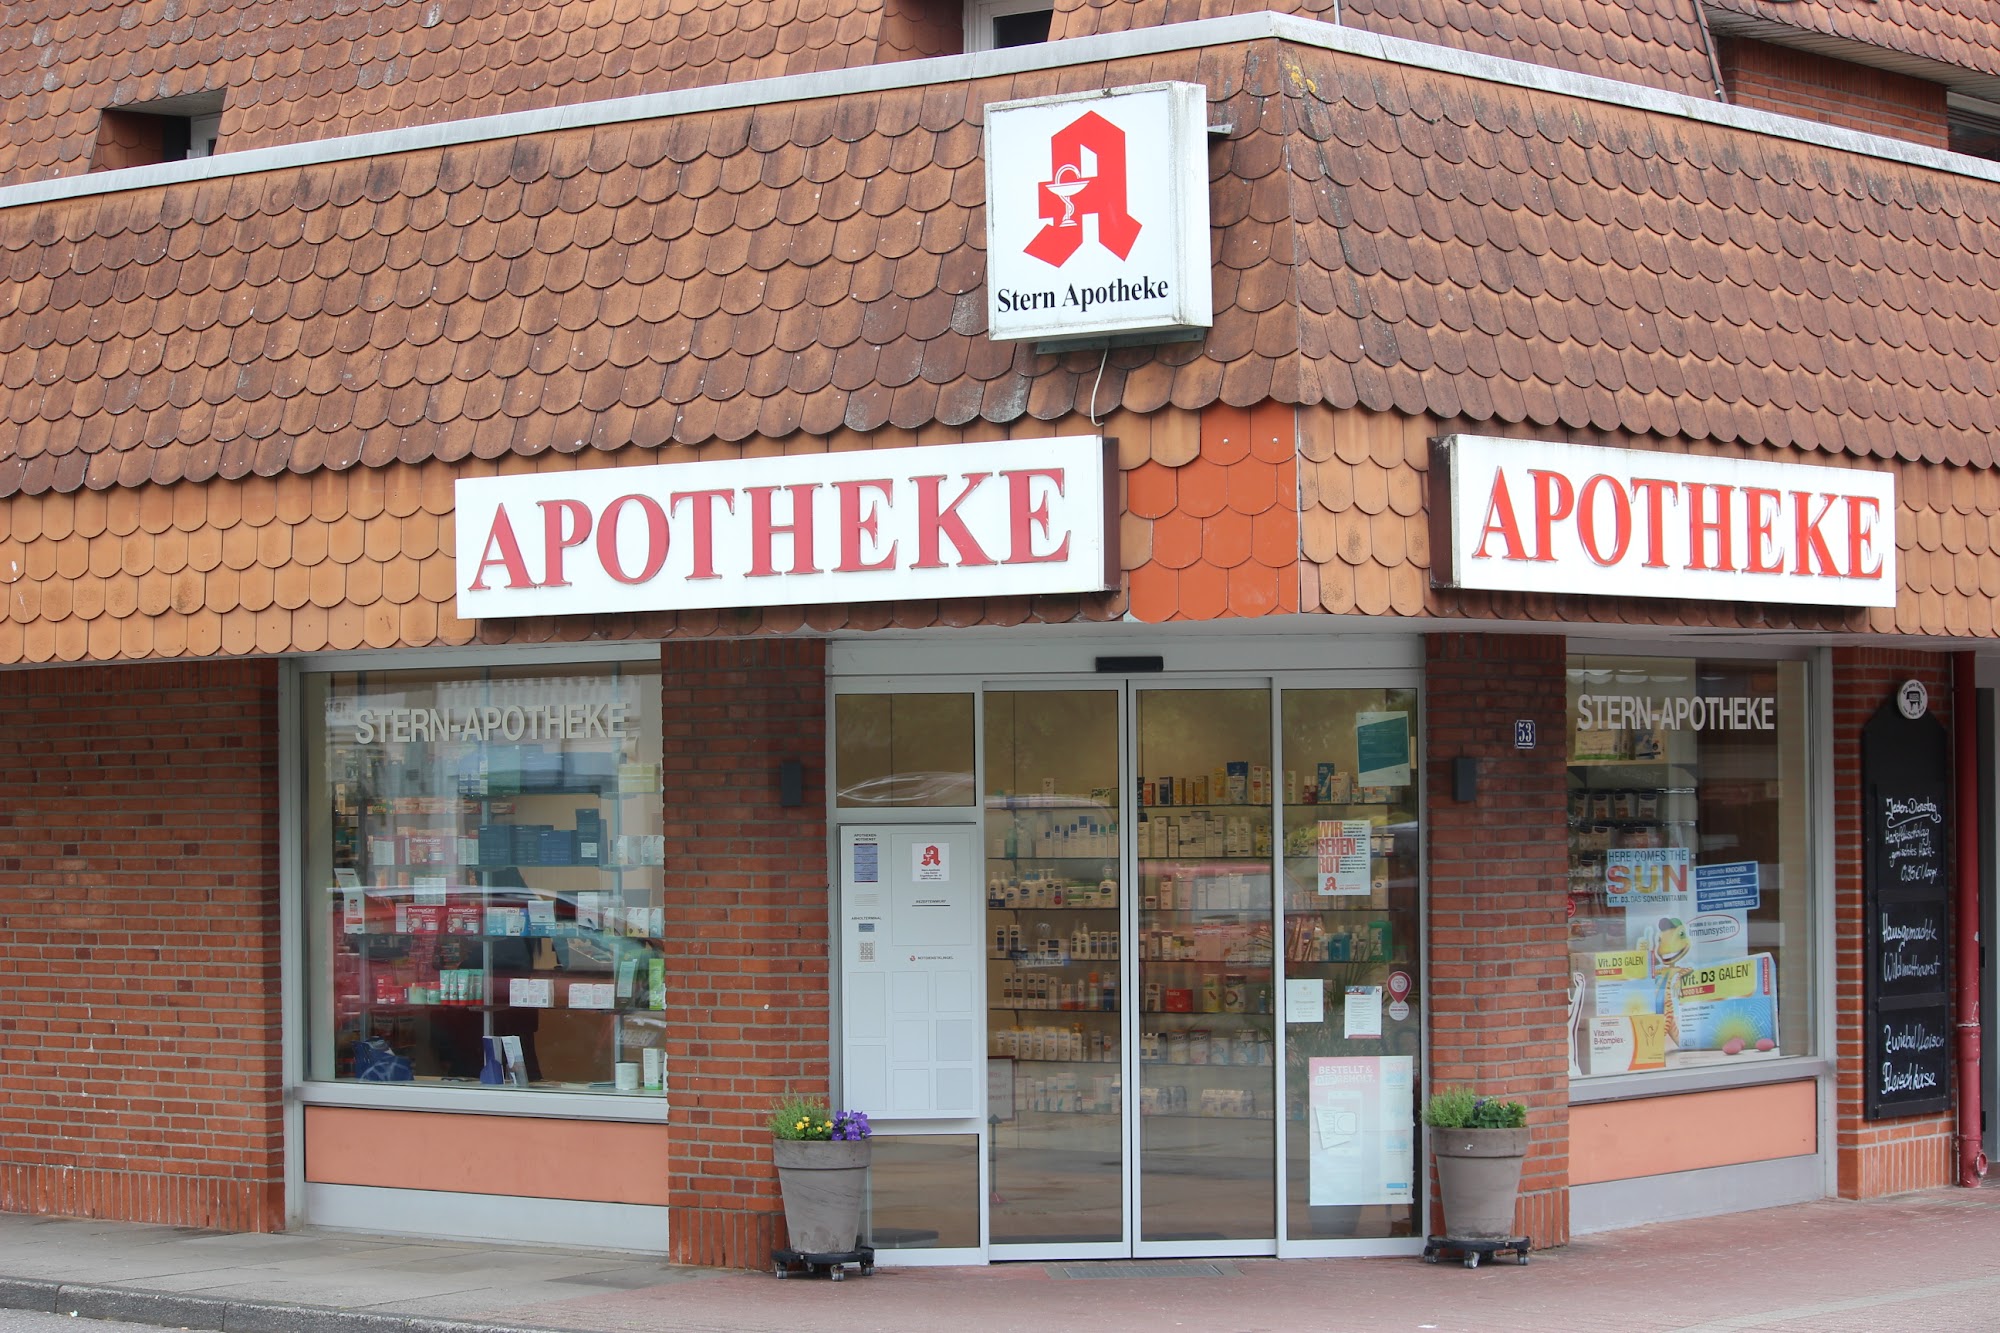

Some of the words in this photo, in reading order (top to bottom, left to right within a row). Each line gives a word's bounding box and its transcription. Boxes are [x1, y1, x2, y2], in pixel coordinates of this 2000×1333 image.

[997, 288, 1055, 313] Stern
[1062, 275, 1169, 313] Apotheke
[467, 467, 1072, 592] APOTHEKE
[1471, 465, 1884, 580] APOTHEKE
[1577, 693, 1775, 732] STERN-APOTHEKE
[355, 703, 630, 745] STERN-APOTHEKE
[1518, 722, 1532, 742] 53
[1318, 821, 1343, 837] WIR
[1318, 838, 1356, 855] SEHEN
[1608, 851, 1631, 862] HERE
[1634, 850, 1666, 862] COMES
[1669, 850, 1687, 860] THE
[1318, 856, 1341, 873] ROT
[1607, 864, 1688, 895] SUN
[1688, 925, 1736, 936] Immunsystem
[1882, 912, 1938, 952] Hausgemachte
[1598, 958, 1611, 968] Vit.
[1612, 957, 1623, 967] D3
[1624, 956, 1644, 966] GALEN
[1701, 970, 1716, 984] D3
[1718, 963, 1749, 981] GALEN
[1593, 1029, 1614, 1037] Vitamin
[1318, 1065, 1365, 1075] BESTELLT
